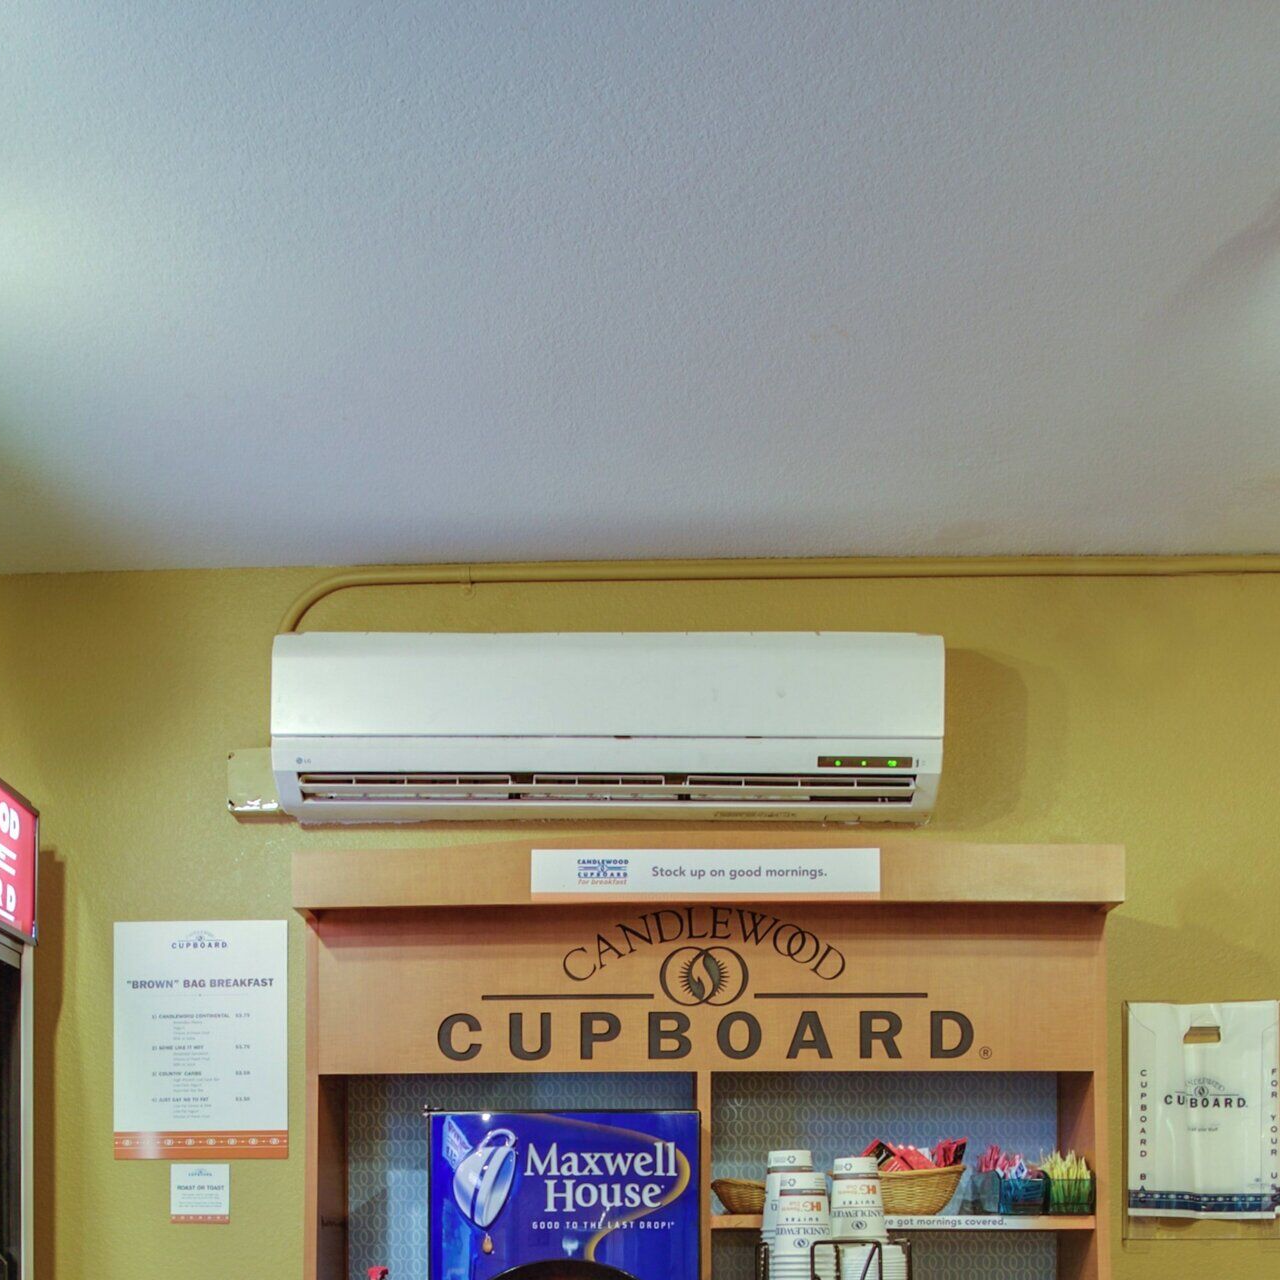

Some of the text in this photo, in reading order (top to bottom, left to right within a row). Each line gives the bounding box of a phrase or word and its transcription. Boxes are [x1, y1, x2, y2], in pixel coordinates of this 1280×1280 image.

[576, 858, 629, 867] CANDLEWOOD
[576, 871, 628, 879] CUPBOARD
[651, 865, 829, 882] Stock up on good mornings.
[171, 941, 228, 950] CUPBOARD
[562, 906, 847, 983] CANDLEWOOD
[126, 977, 275, 990] "BROWN" BAG BREAKFAST
[437, 1010, 976, 1062] CUPBOARD
[1163, 1094, 1246, 1109] CUBOARD
[524, 1141, 678, 1177] Maxwell
[543, 1179, 663, 1213] House
[532, 1220, 560, 1230] GOOD
[565, 1220, 579, 1230] TO
[583, 1220, 604, 1230] THE
[607, 1220, 635, 1230] LAST
[897, 1217, 1008, 1228] got mornings covered.
